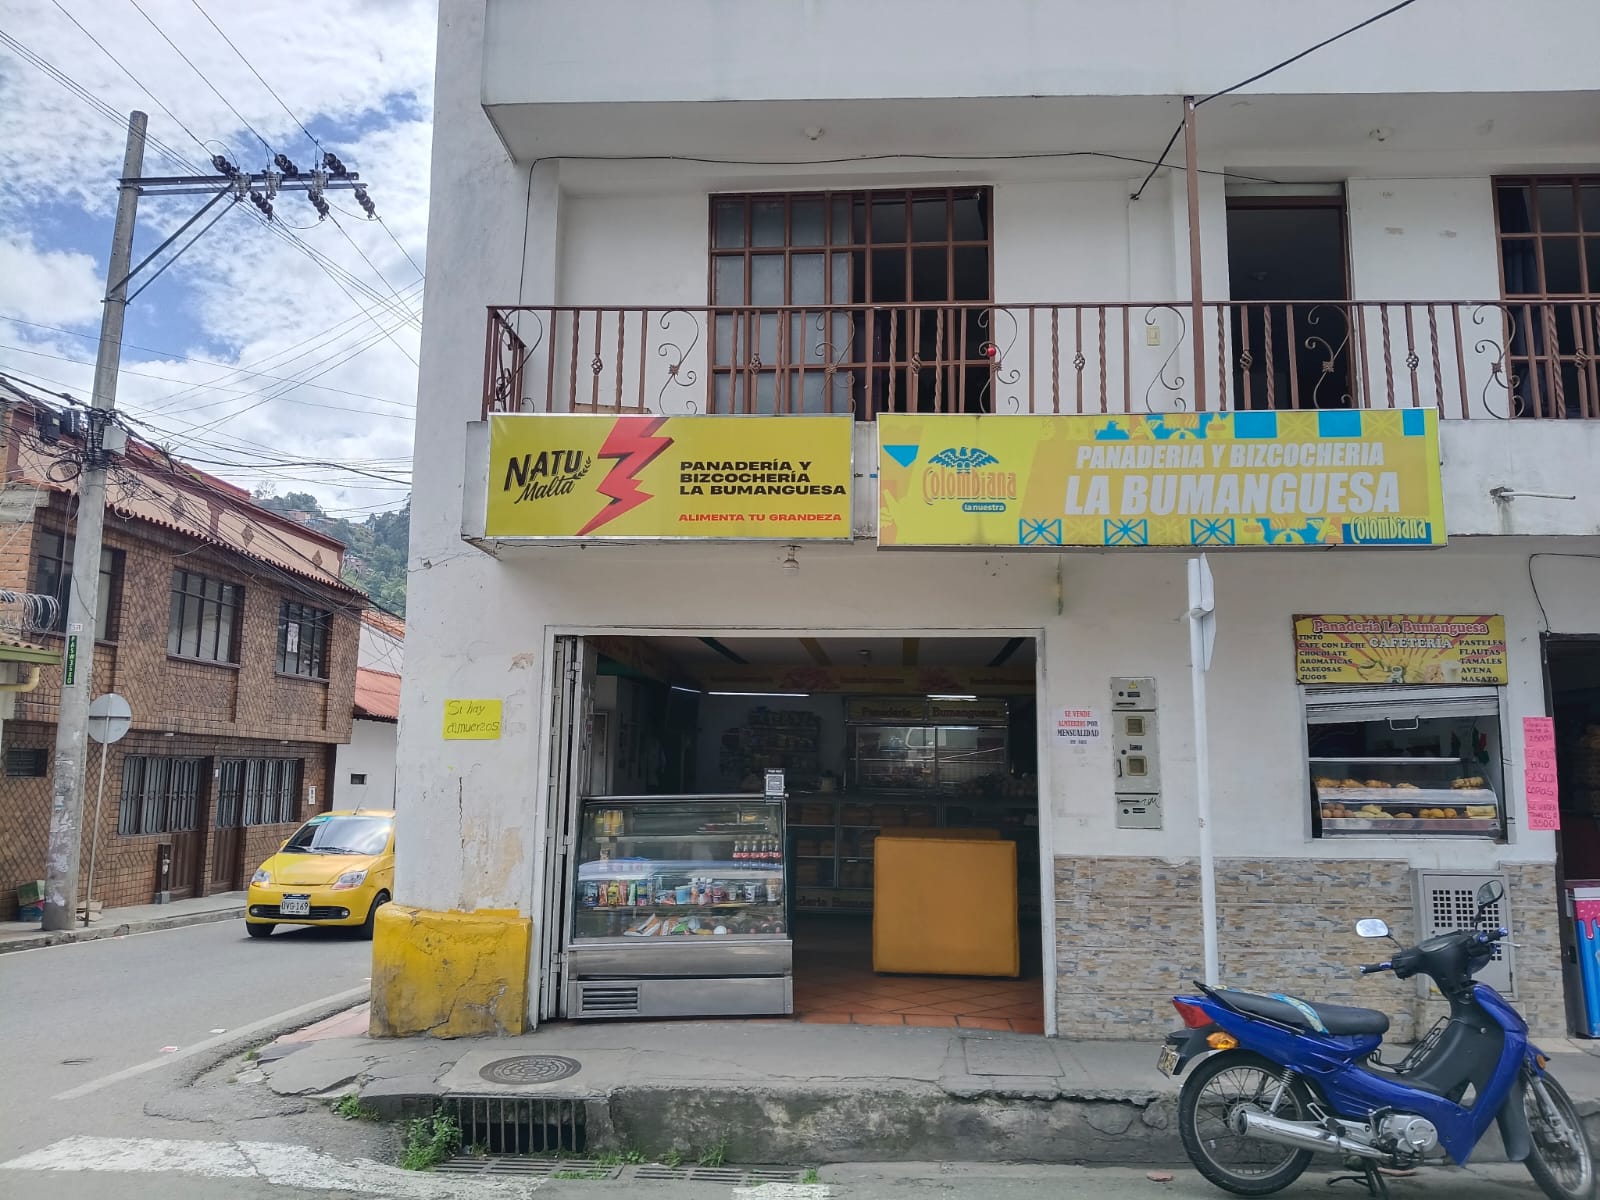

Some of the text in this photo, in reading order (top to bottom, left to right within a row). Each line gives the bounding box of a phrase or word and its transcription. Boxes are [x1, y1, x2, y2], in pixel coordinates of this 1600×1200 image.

[1075, 442, 1384, 470] PANADERIA Y BIZCOCHERIA
[503, 449, 584, 492] NATU
[680, 458, 812, 471] PANADERÍA Y
[680, 471, 811, 483] BIZCOCHERÍA
[513, 475, 576, 504] Malta
[679, 485, 847, 495] LA BUMANGUESA
[922, 466, 1017, 505] Colombiana
[1064, 471, 1400, 516] LA BUMANGUESA
[679, 513, 842, 522] ALIMENTA TU GRANDEZA
[1350, 516, 1427, 544] Colombiana
[1383, 620, 1400, 633] La
[1402, 621, 1488, 635] Bumanguesa
[1369, 635, 1453, 648] CAFETERÍA
[1057, 729, 1099, 737] MENSUALIDAD
